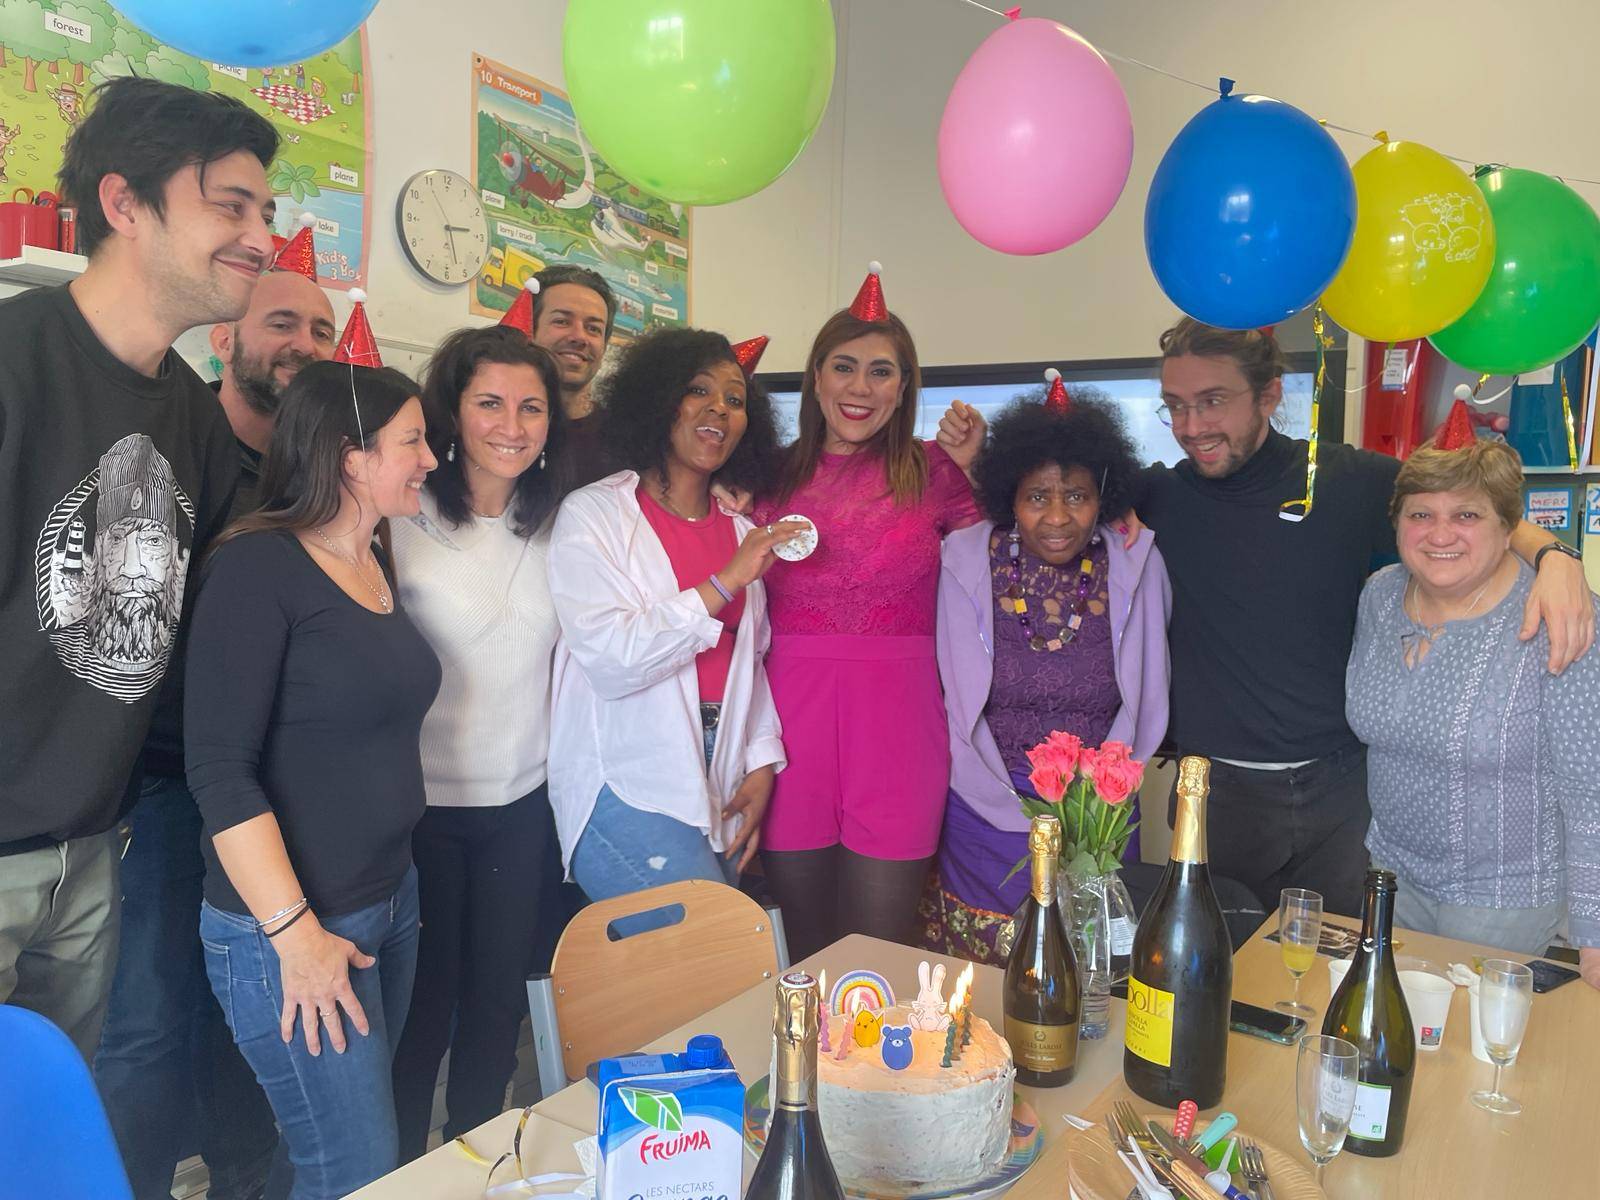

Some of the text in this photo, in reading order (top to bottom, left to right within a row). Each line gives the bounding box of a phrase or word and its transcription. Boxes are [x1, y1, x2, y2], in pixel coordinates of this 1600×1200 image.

[53, 17, 84, 36] forest
[481, 70, 537, 101] 10 Transport
[334, 170, 354, 183] plant
[424, 176, 433, 186] 11
[443, 175, 452, 185] 12
[410, 189, 419, 200] 10
[407, 212, 412, 222] 9
[475, 208, 480, 217] 2
[318, 221, 334, 232] lake
[411, 238, 417, 247] 8
[480, 234, 484, 243] 3
[316, 249, 347, 265] Kid's
[475, 256, 480, 265] 4
[425, 260, 431, 269] 7
[330, 264, 362, 281] 3 Box
[444, 271, 449, 280] 6
[463, 269, 468, 278] 5
[646, 1186, 662, 1197] LES
[666, 1181, 714, 1195] NECTARS
